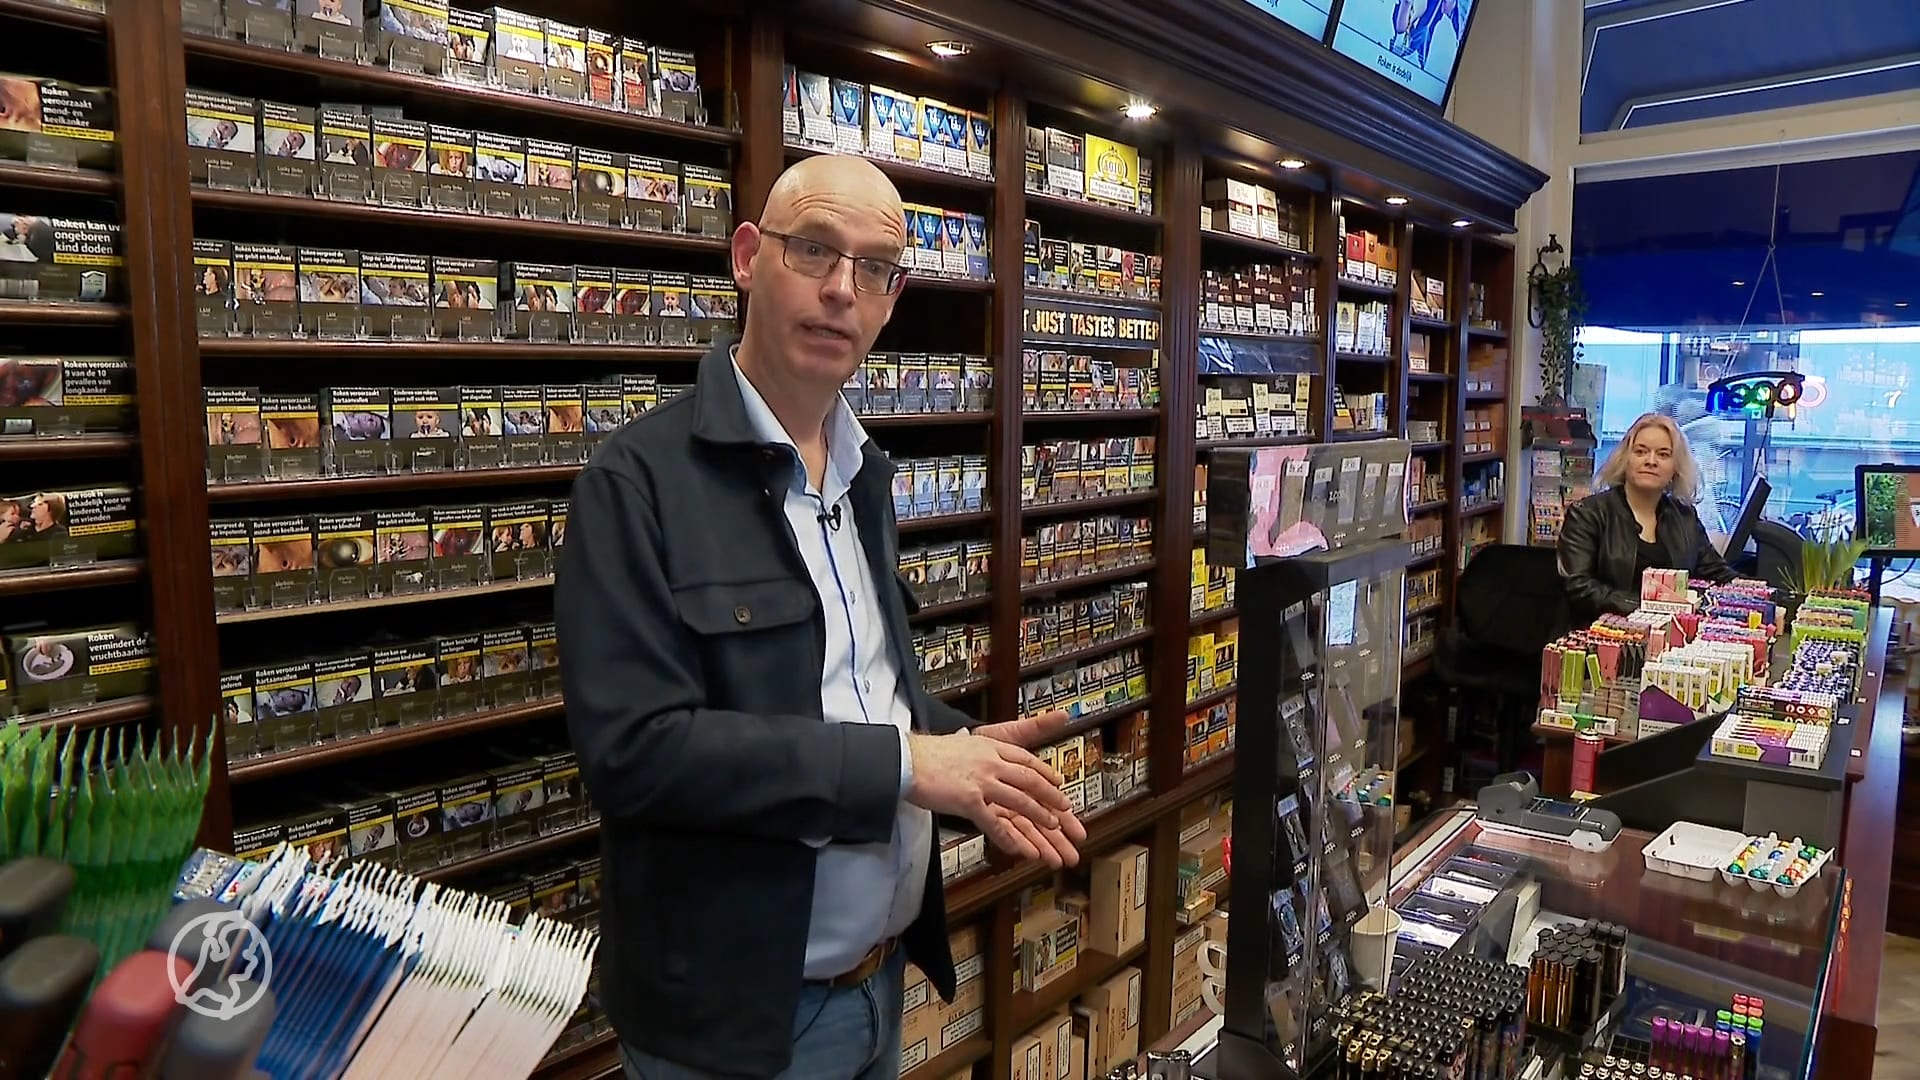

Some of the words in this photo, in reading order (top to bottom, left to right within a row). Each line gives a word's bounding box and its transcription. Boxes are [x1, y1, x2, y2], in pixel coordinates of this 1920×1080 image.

[1377, 56, 1391, 71] Roken
[1396, 65, 1412, 82] dodelijk
[41, 86, 69, 96] Roken
[42, 97, 93, 109] veroorzaakt
[43, 107, 71, 116] mond-
[44, 114, 90, 127] keelkanker
[52, 218, 87, 229] Roken
[87, 220, 107, 231] kan
[924, 220, 936, 234] blu
[948, 223, 960, 235] blu
[54, 230, 111, 243] ongeboren
[971, 226, 981, 239] blu
[55, 241, 79, 253] kind
[81, 243, 113, 254] doden
[1032, 310, 1066, 335] JUST
[1070, 313, 1115, 338] TASTES
[1119, 319, 1159, 340] BETTER
[64, 361, 88, 369] Roken
[65, 379, 97, 387] gevallen
[66, 387, 107, 395] longkanker
[67, 492, 79, 500] Uw
[68, 498, 103, 508] schadelijk
[69, 507, 102, 516] kinderen,
[104, 505, 127, 513] familie
[80, 514, 111, 523] vrienden
[272, 520, 304, 528] veroorzaakt
[281, 526, 310, 534] keelkanker
[88, 633, 115, 643] Roken
[89, 639, 135, 652] vermindert
[90, 648, 149, 662] vruchtbaarhei
[256, 670, 275, 678] Roken
[276, 664, 310, 675] veroorzaakt
[256, 674, 297, 685] hartaanvallen
[306, 818, 334, 829] beschadigt
